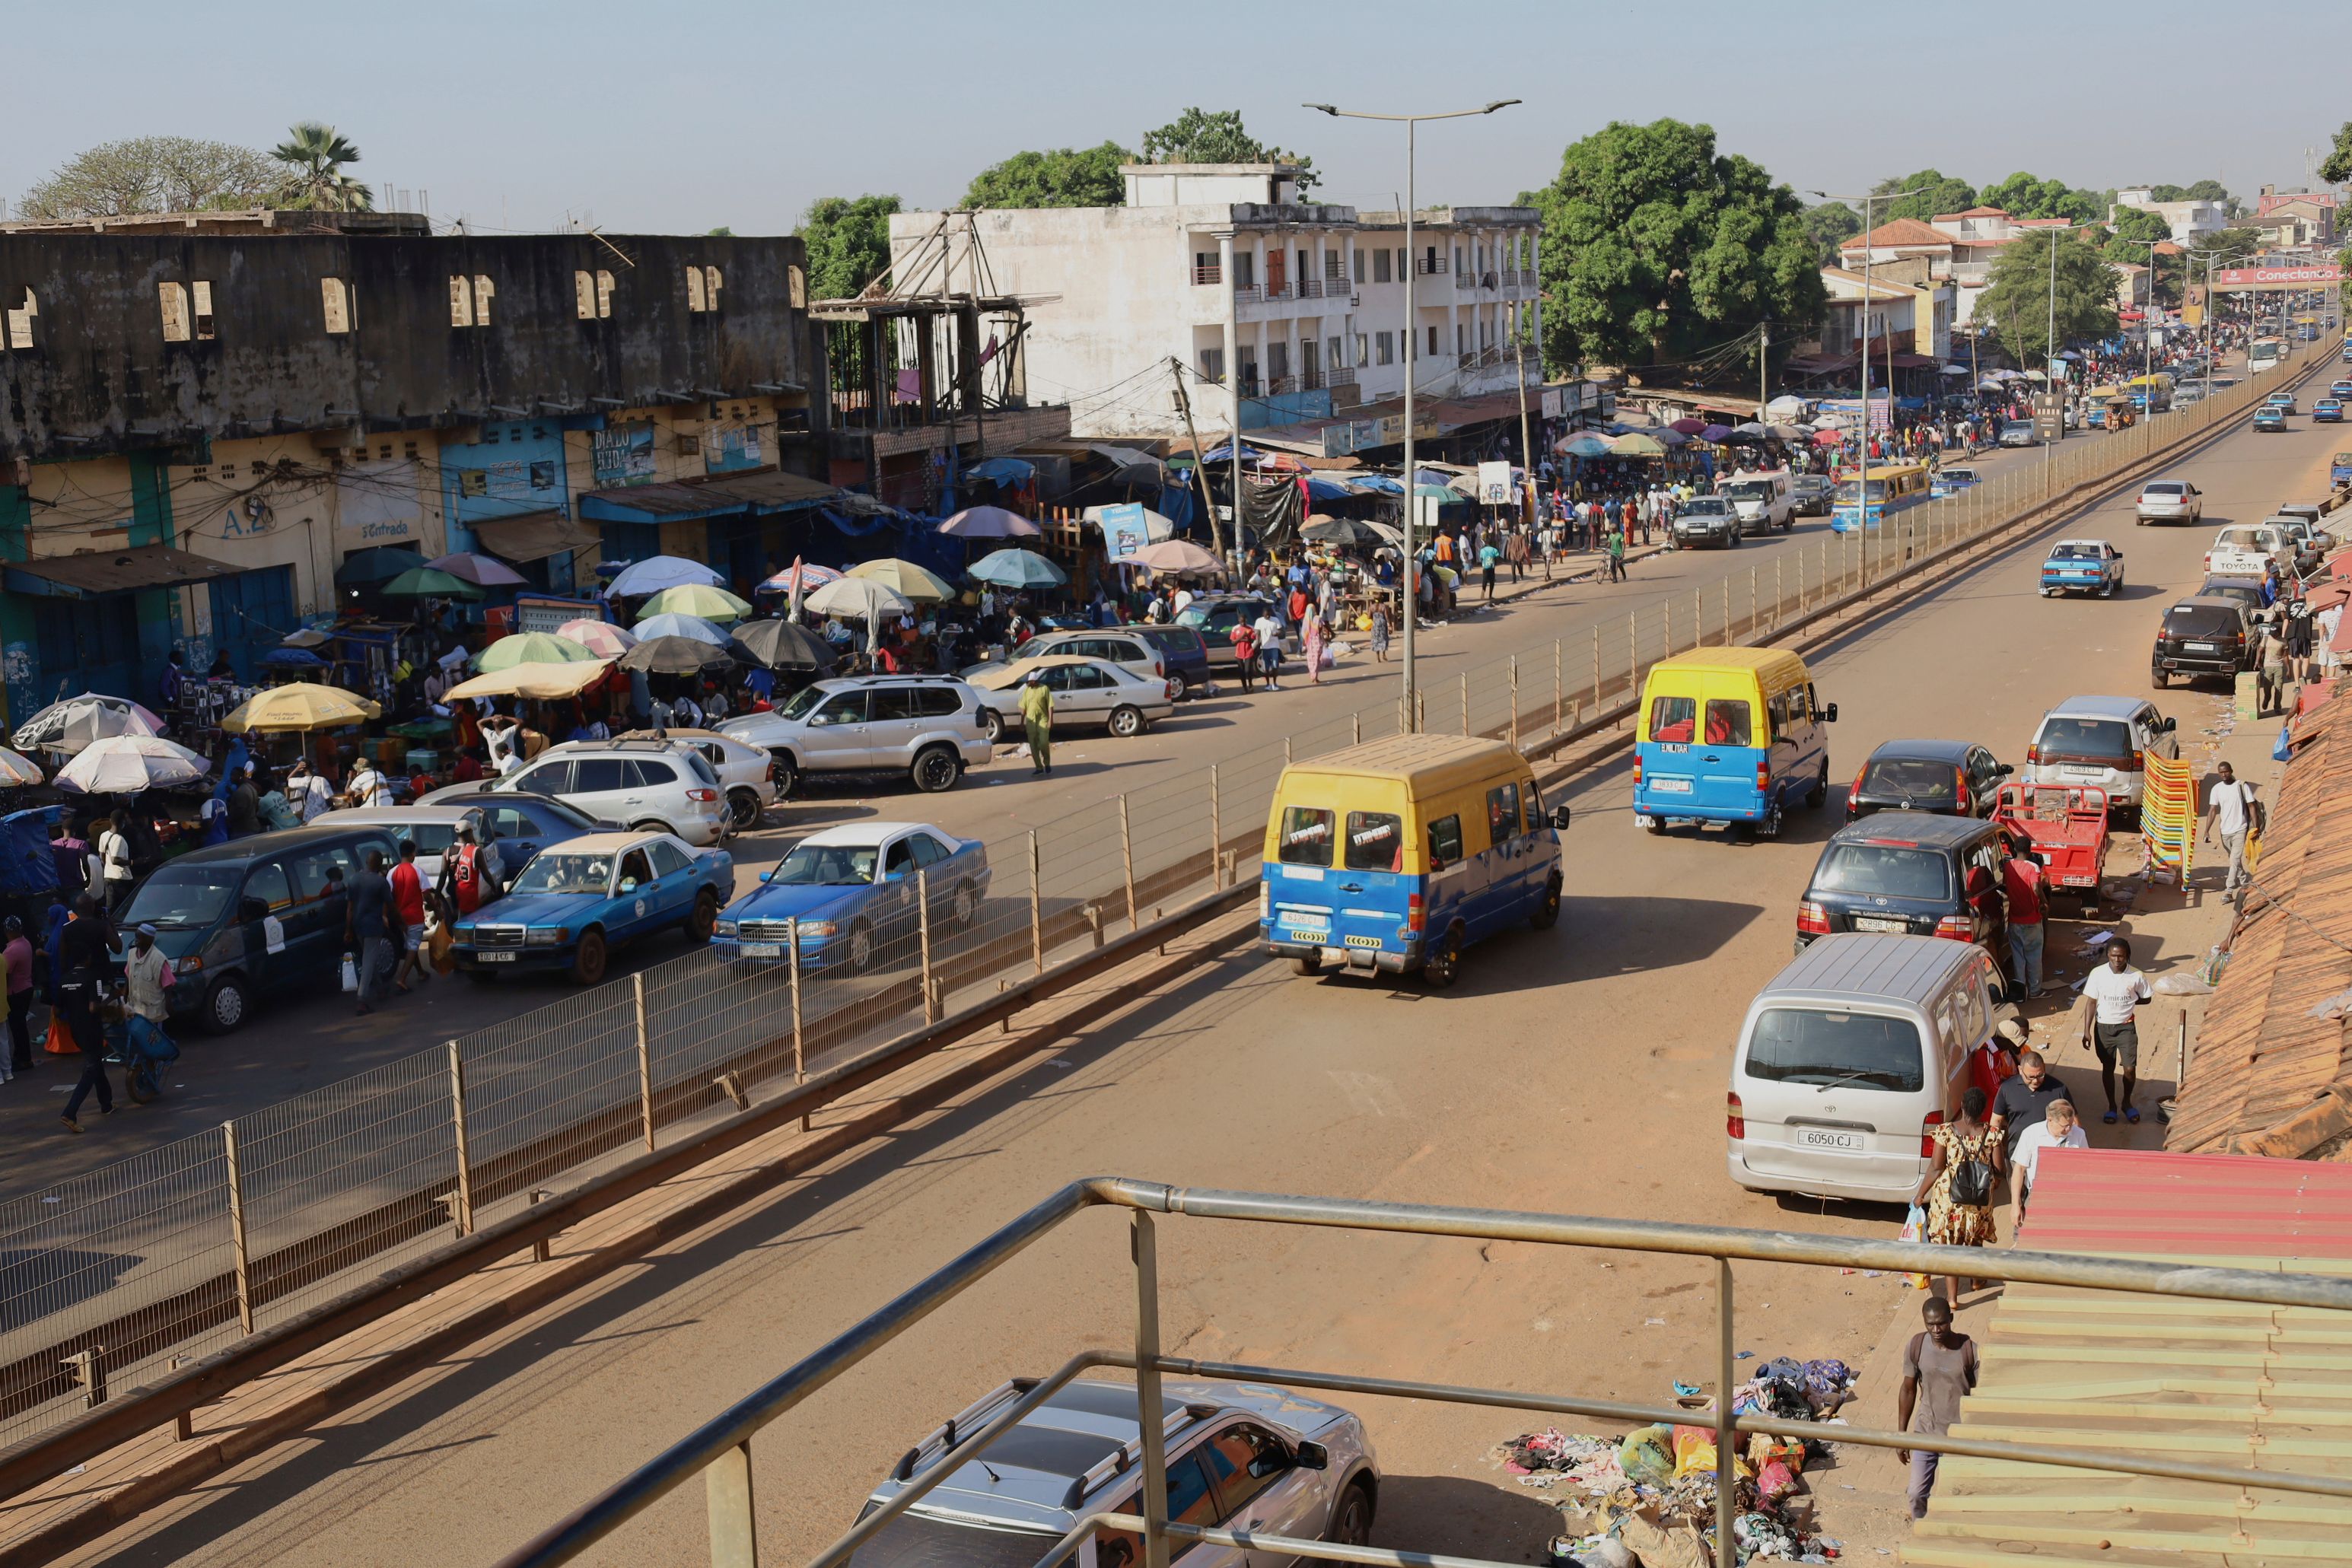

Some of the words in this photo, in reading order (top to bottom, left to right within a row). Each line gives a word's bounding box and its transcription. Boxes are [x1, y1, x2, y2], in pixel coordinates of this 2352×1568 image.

[2255, 269, 2334, 281] Conectando
[1863, 919, 1883, 928] 2896
[1808, 1133, 1835, 1145] 6050
[1837, 1136, 1851, 1147] CJ
